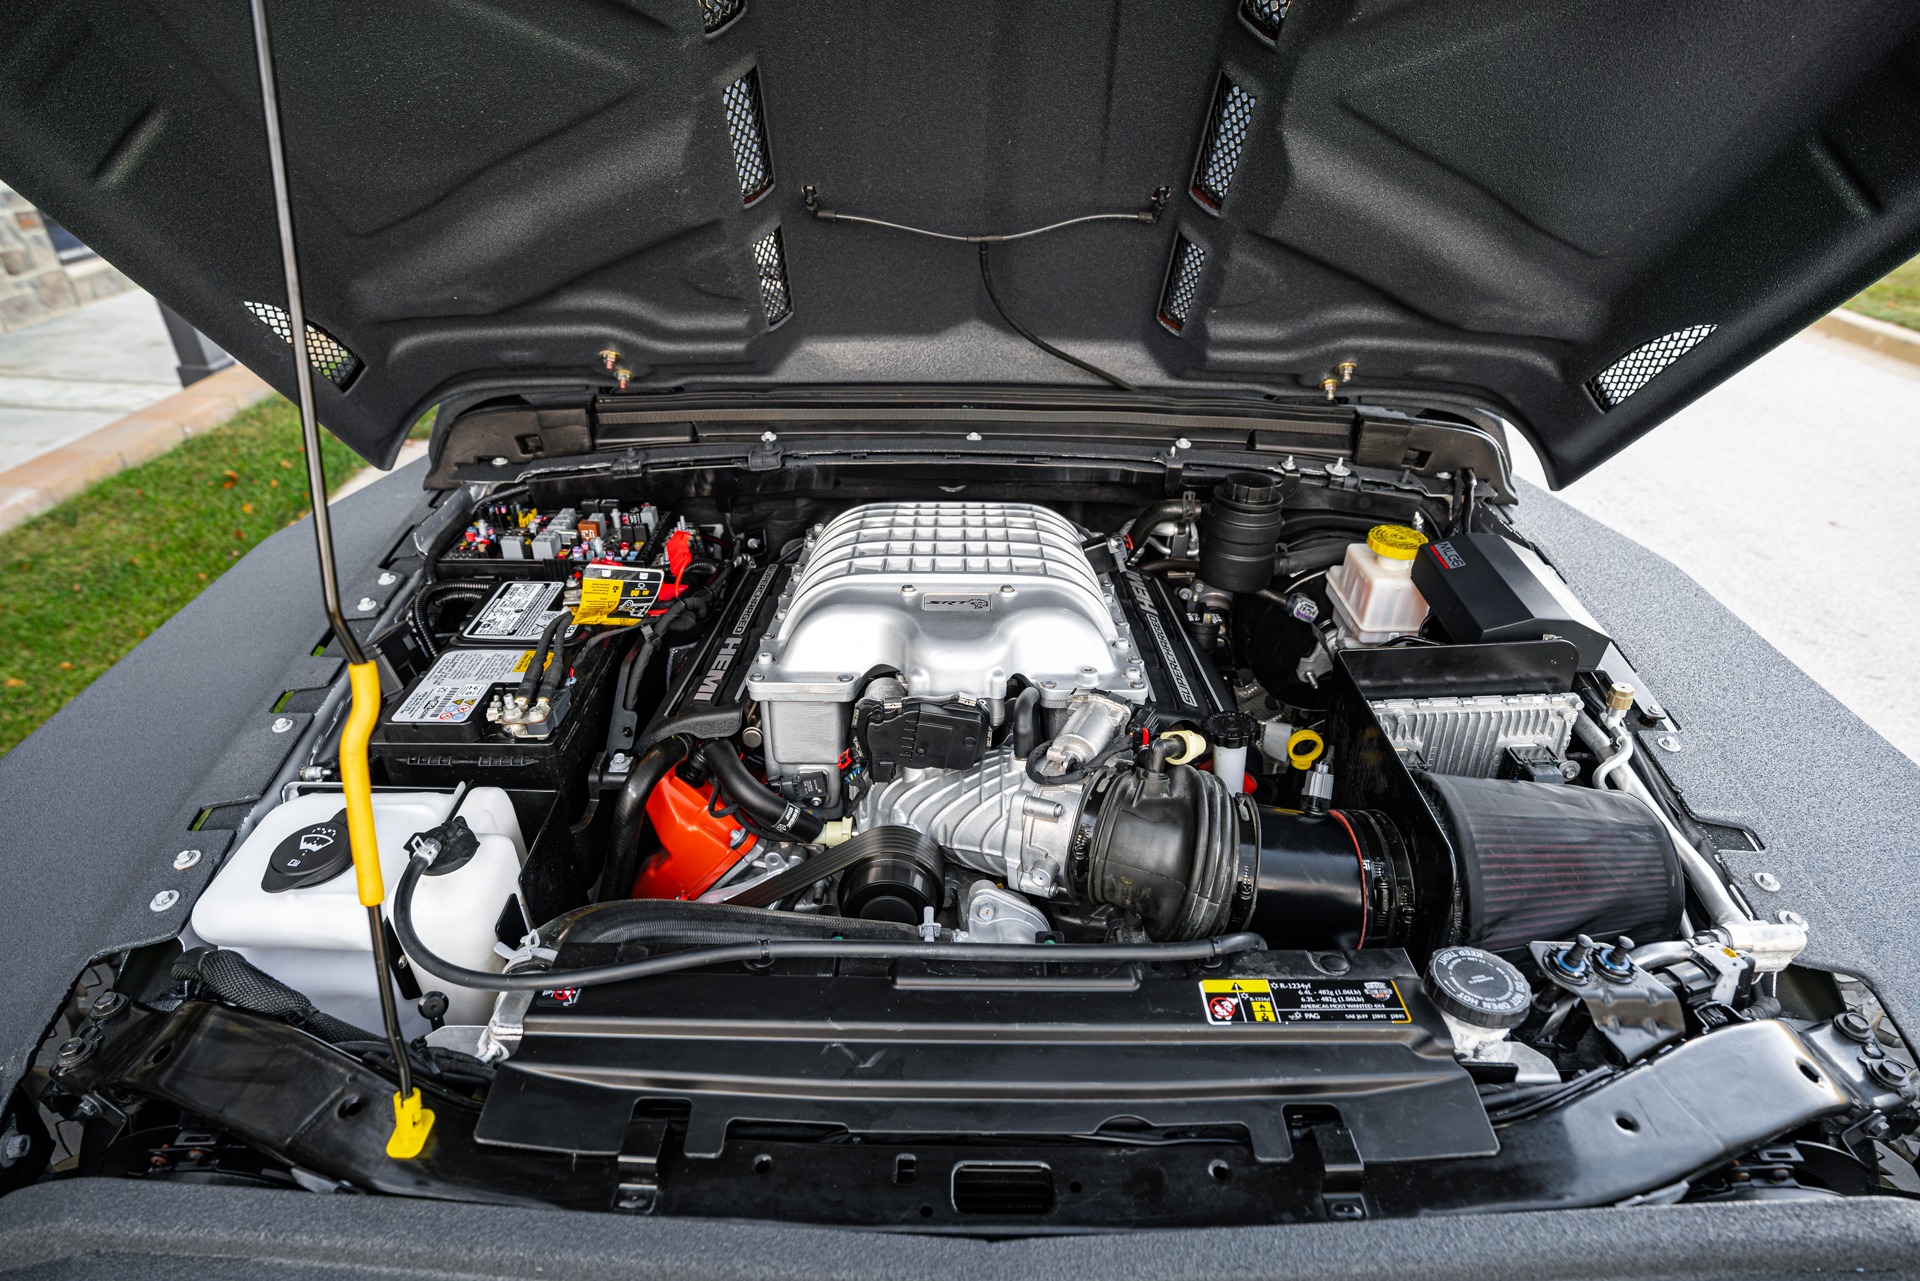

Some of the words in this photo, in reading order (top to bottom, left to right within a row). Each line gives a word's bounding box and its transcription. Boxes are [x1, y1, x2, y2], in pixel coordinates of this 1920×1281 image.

[735, 564, 778, 634] SUPERCHARGED
[1125, 570, 1159, 616] HEMI
[1148, 614, 1196, 706] SUPERCHARGED
[693, 637, 743, 701] HEMI
[1437, 951, 1459, 966] TIGHT
[1458, 950, 1483, 958] KEEP
[1279, 982, 1311, 990] R-1234yf
[1514, 981, 1526, 993] DO
[1456, 992, 1479, 1006] HOT
[1482, 1001, 1512, 1010] OPEN
[1512, 994, 1525, 1007] NOT
